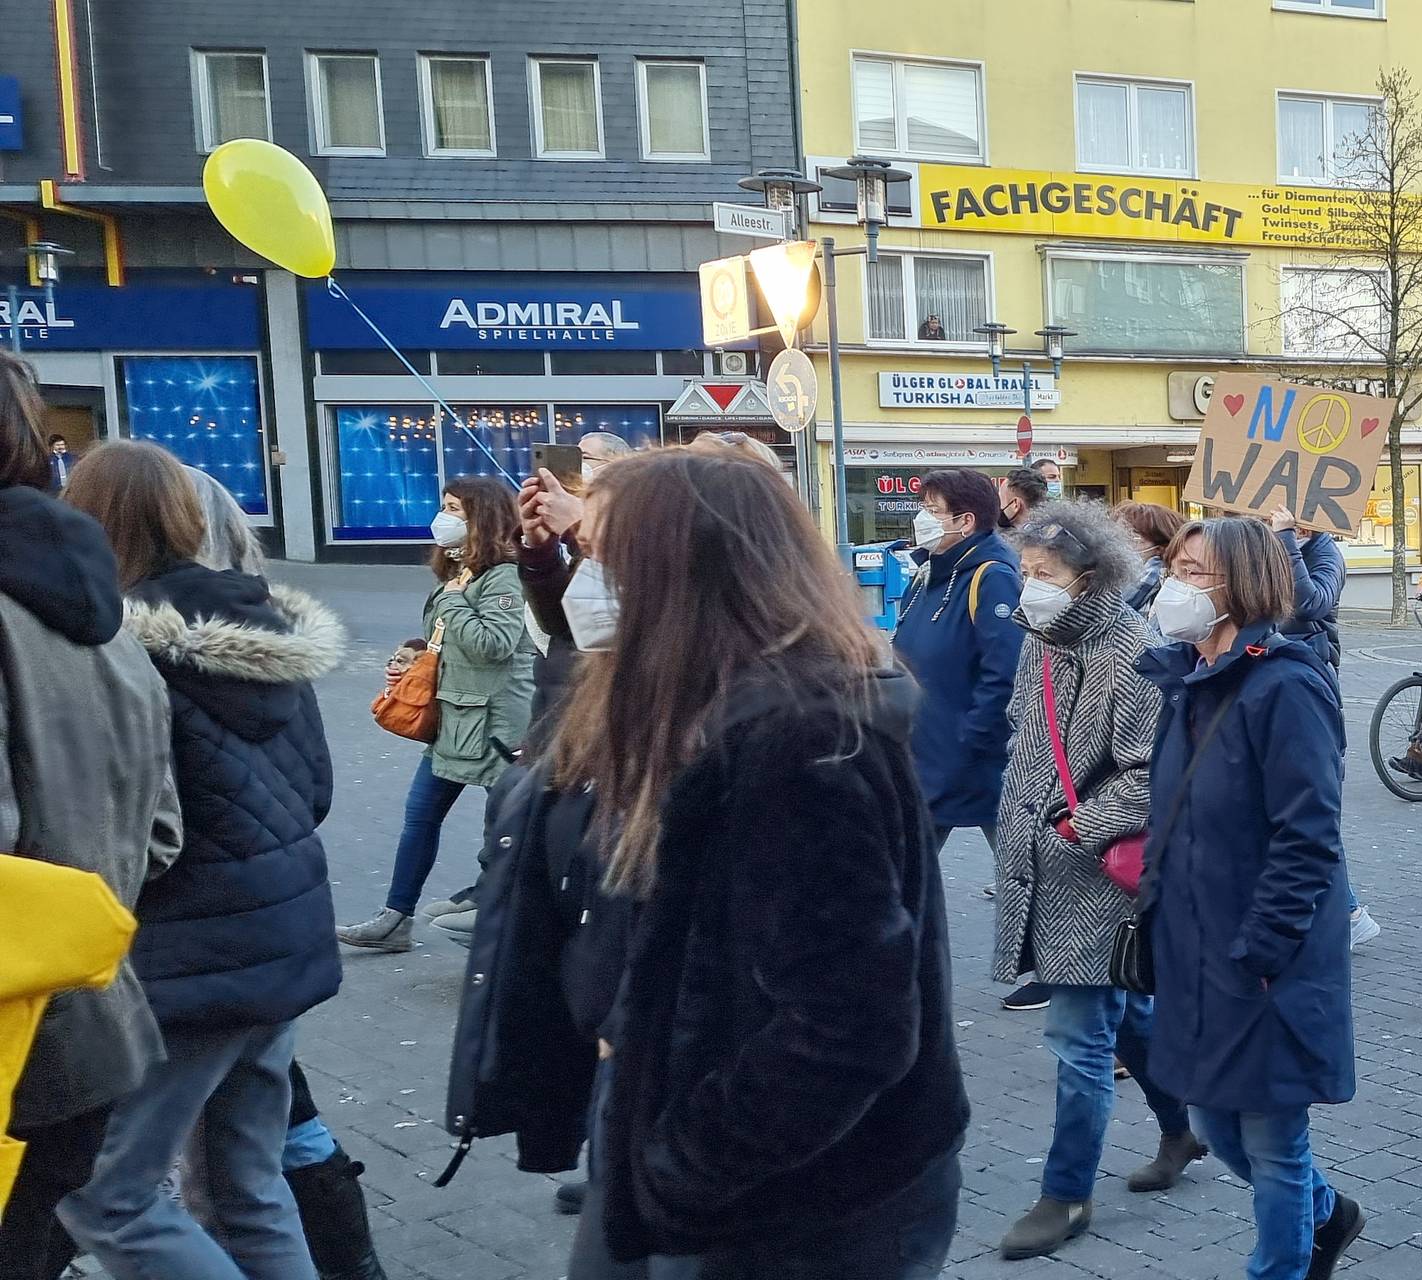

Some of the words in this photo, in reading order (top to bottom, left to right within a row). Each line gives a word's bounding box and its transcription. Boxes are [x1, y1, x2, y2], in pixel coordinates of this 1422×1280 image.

[930, 181, 1243, 239] FACHGESCHÄFT
[730, 212, 774, 231] Alleestr.
[439, 299, 639, 329] ADMIRAL
[478, 329, 615, 340] SPIELHALLE
[892, 374, 935, 389] ÜLGER
[938, 376, 990, 390] GLOBAL
[893, 391, 961, 404] TURKISH
[877, 475, 921, 494] ÜLG
[1202, 437, 1363, 530] WAR
[878, 501, 924, 512] TURKIS
